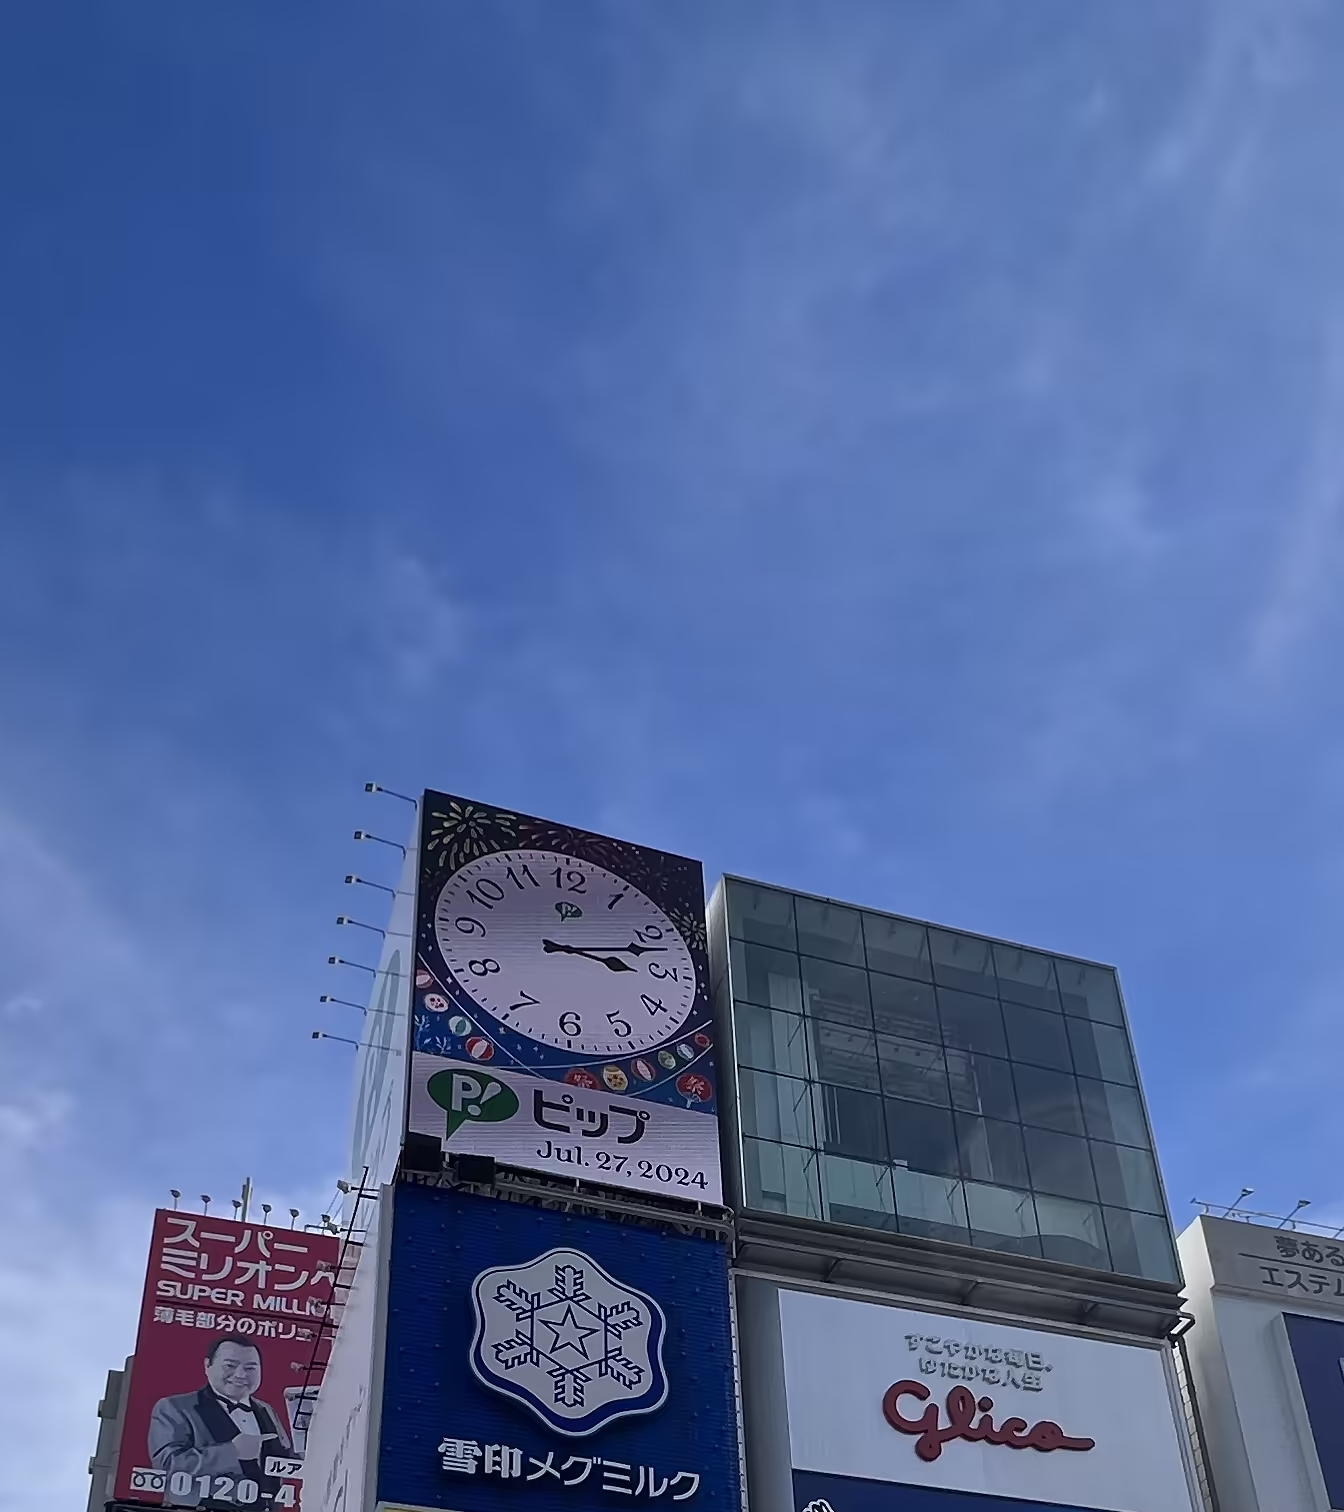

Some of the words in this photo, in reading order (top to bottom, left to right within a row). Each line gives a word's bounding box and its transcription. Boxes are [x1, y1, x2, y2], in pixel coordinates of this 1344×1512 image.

[465, 878, 506, 911] 10
[506, 864, 541, 890] 11
[550, 866, 589, 895] 12
[607, 892, 626, 911] 1
[455, 915, 487, 938] 9
[633, 925, 664, 943] 2
[468, 957, 501, 977] 8
[648, 962, 679, 983] 3
[509, 990, 541, 1012] 7
[559, 1011, 583, 1037] 6
[606, 1011, 633, 1038] 5
[639, 992, 668, 1018] 4
[533, 1087, 651, 1145] ピップ
[163, 1216, 309, 1258] スーパー
[156, 1280, 244, 1306] SUPER
[882, 1379, 1095, 1462] Glico
[437, 1436, 701, 1501] 雪印メグミルク
